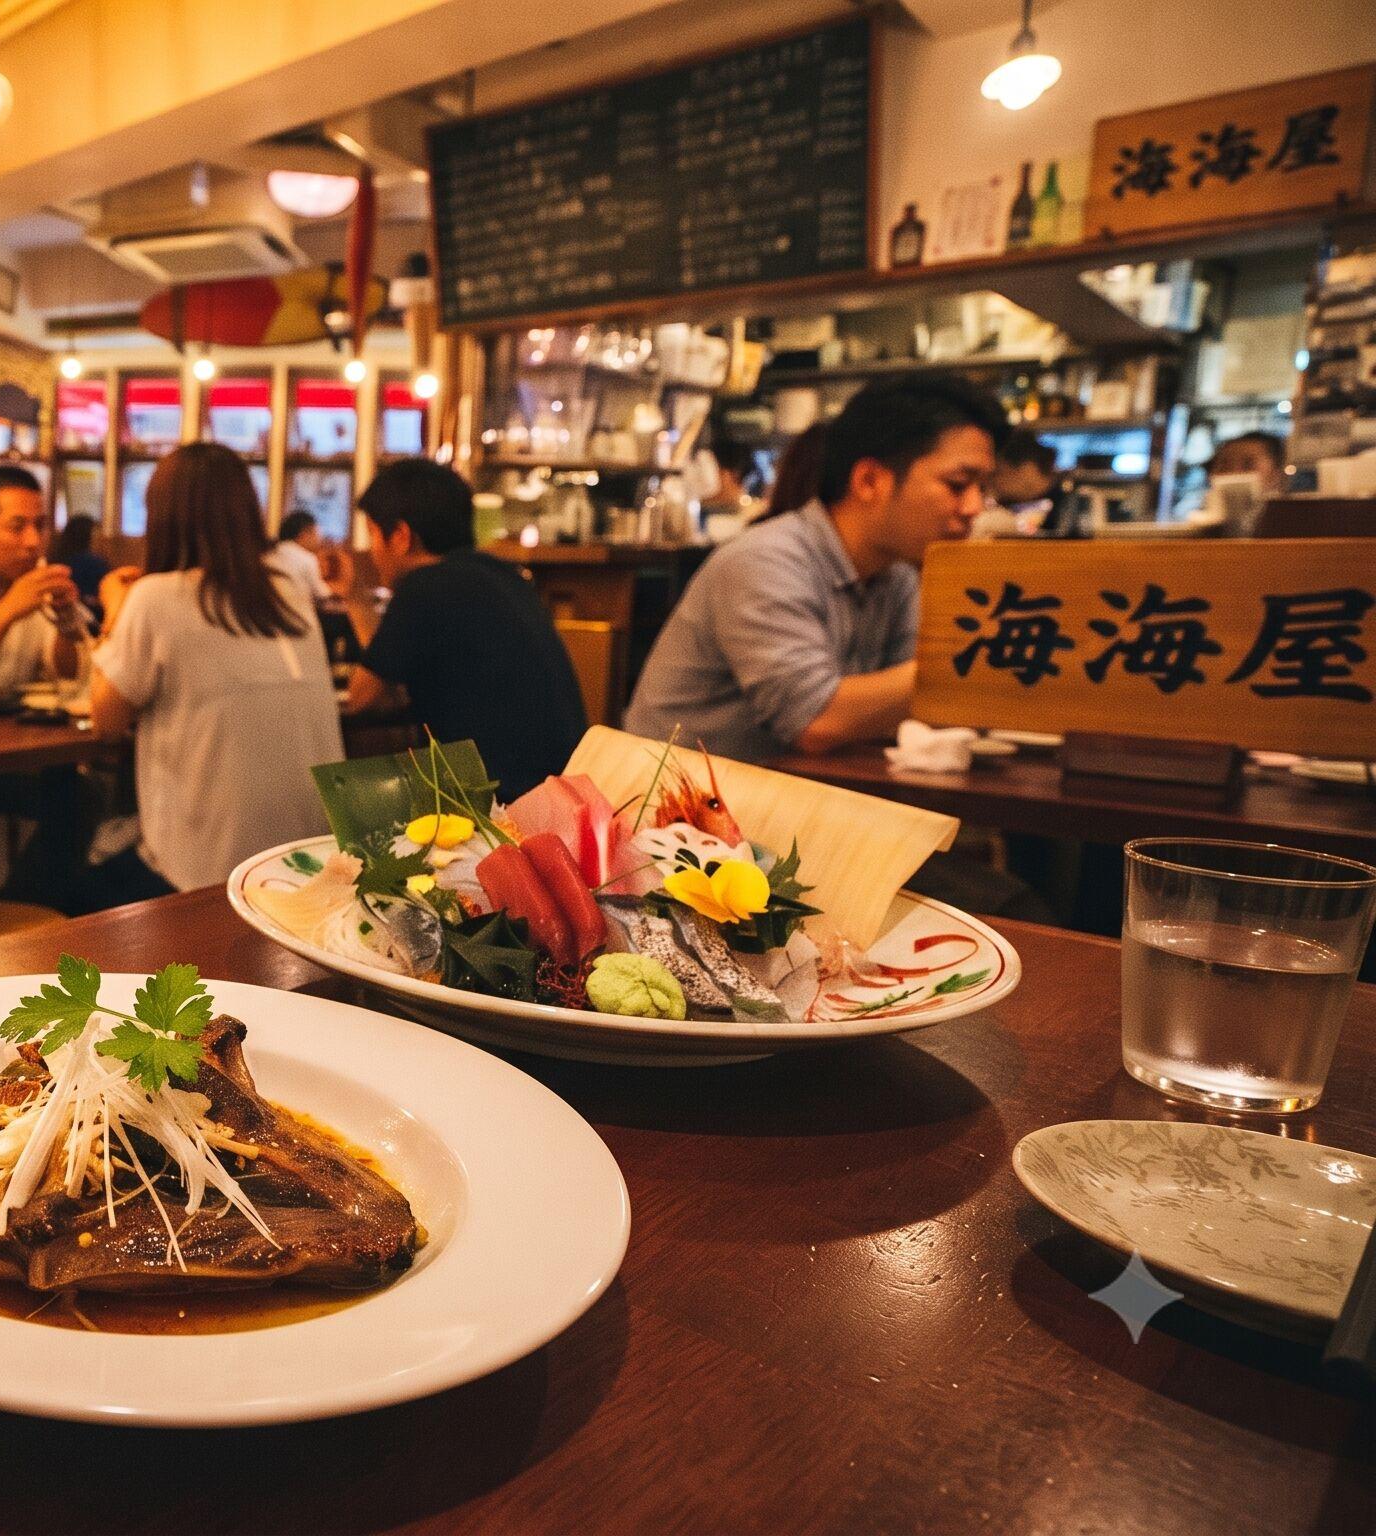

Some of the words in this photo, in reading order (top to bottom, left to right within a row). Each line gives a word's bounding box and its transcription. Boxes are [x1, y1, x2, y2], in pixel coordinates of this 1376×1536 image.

[1111, 104, 1341, 198] 海海屋
[953, 582, 1376, 704] 海海屋
